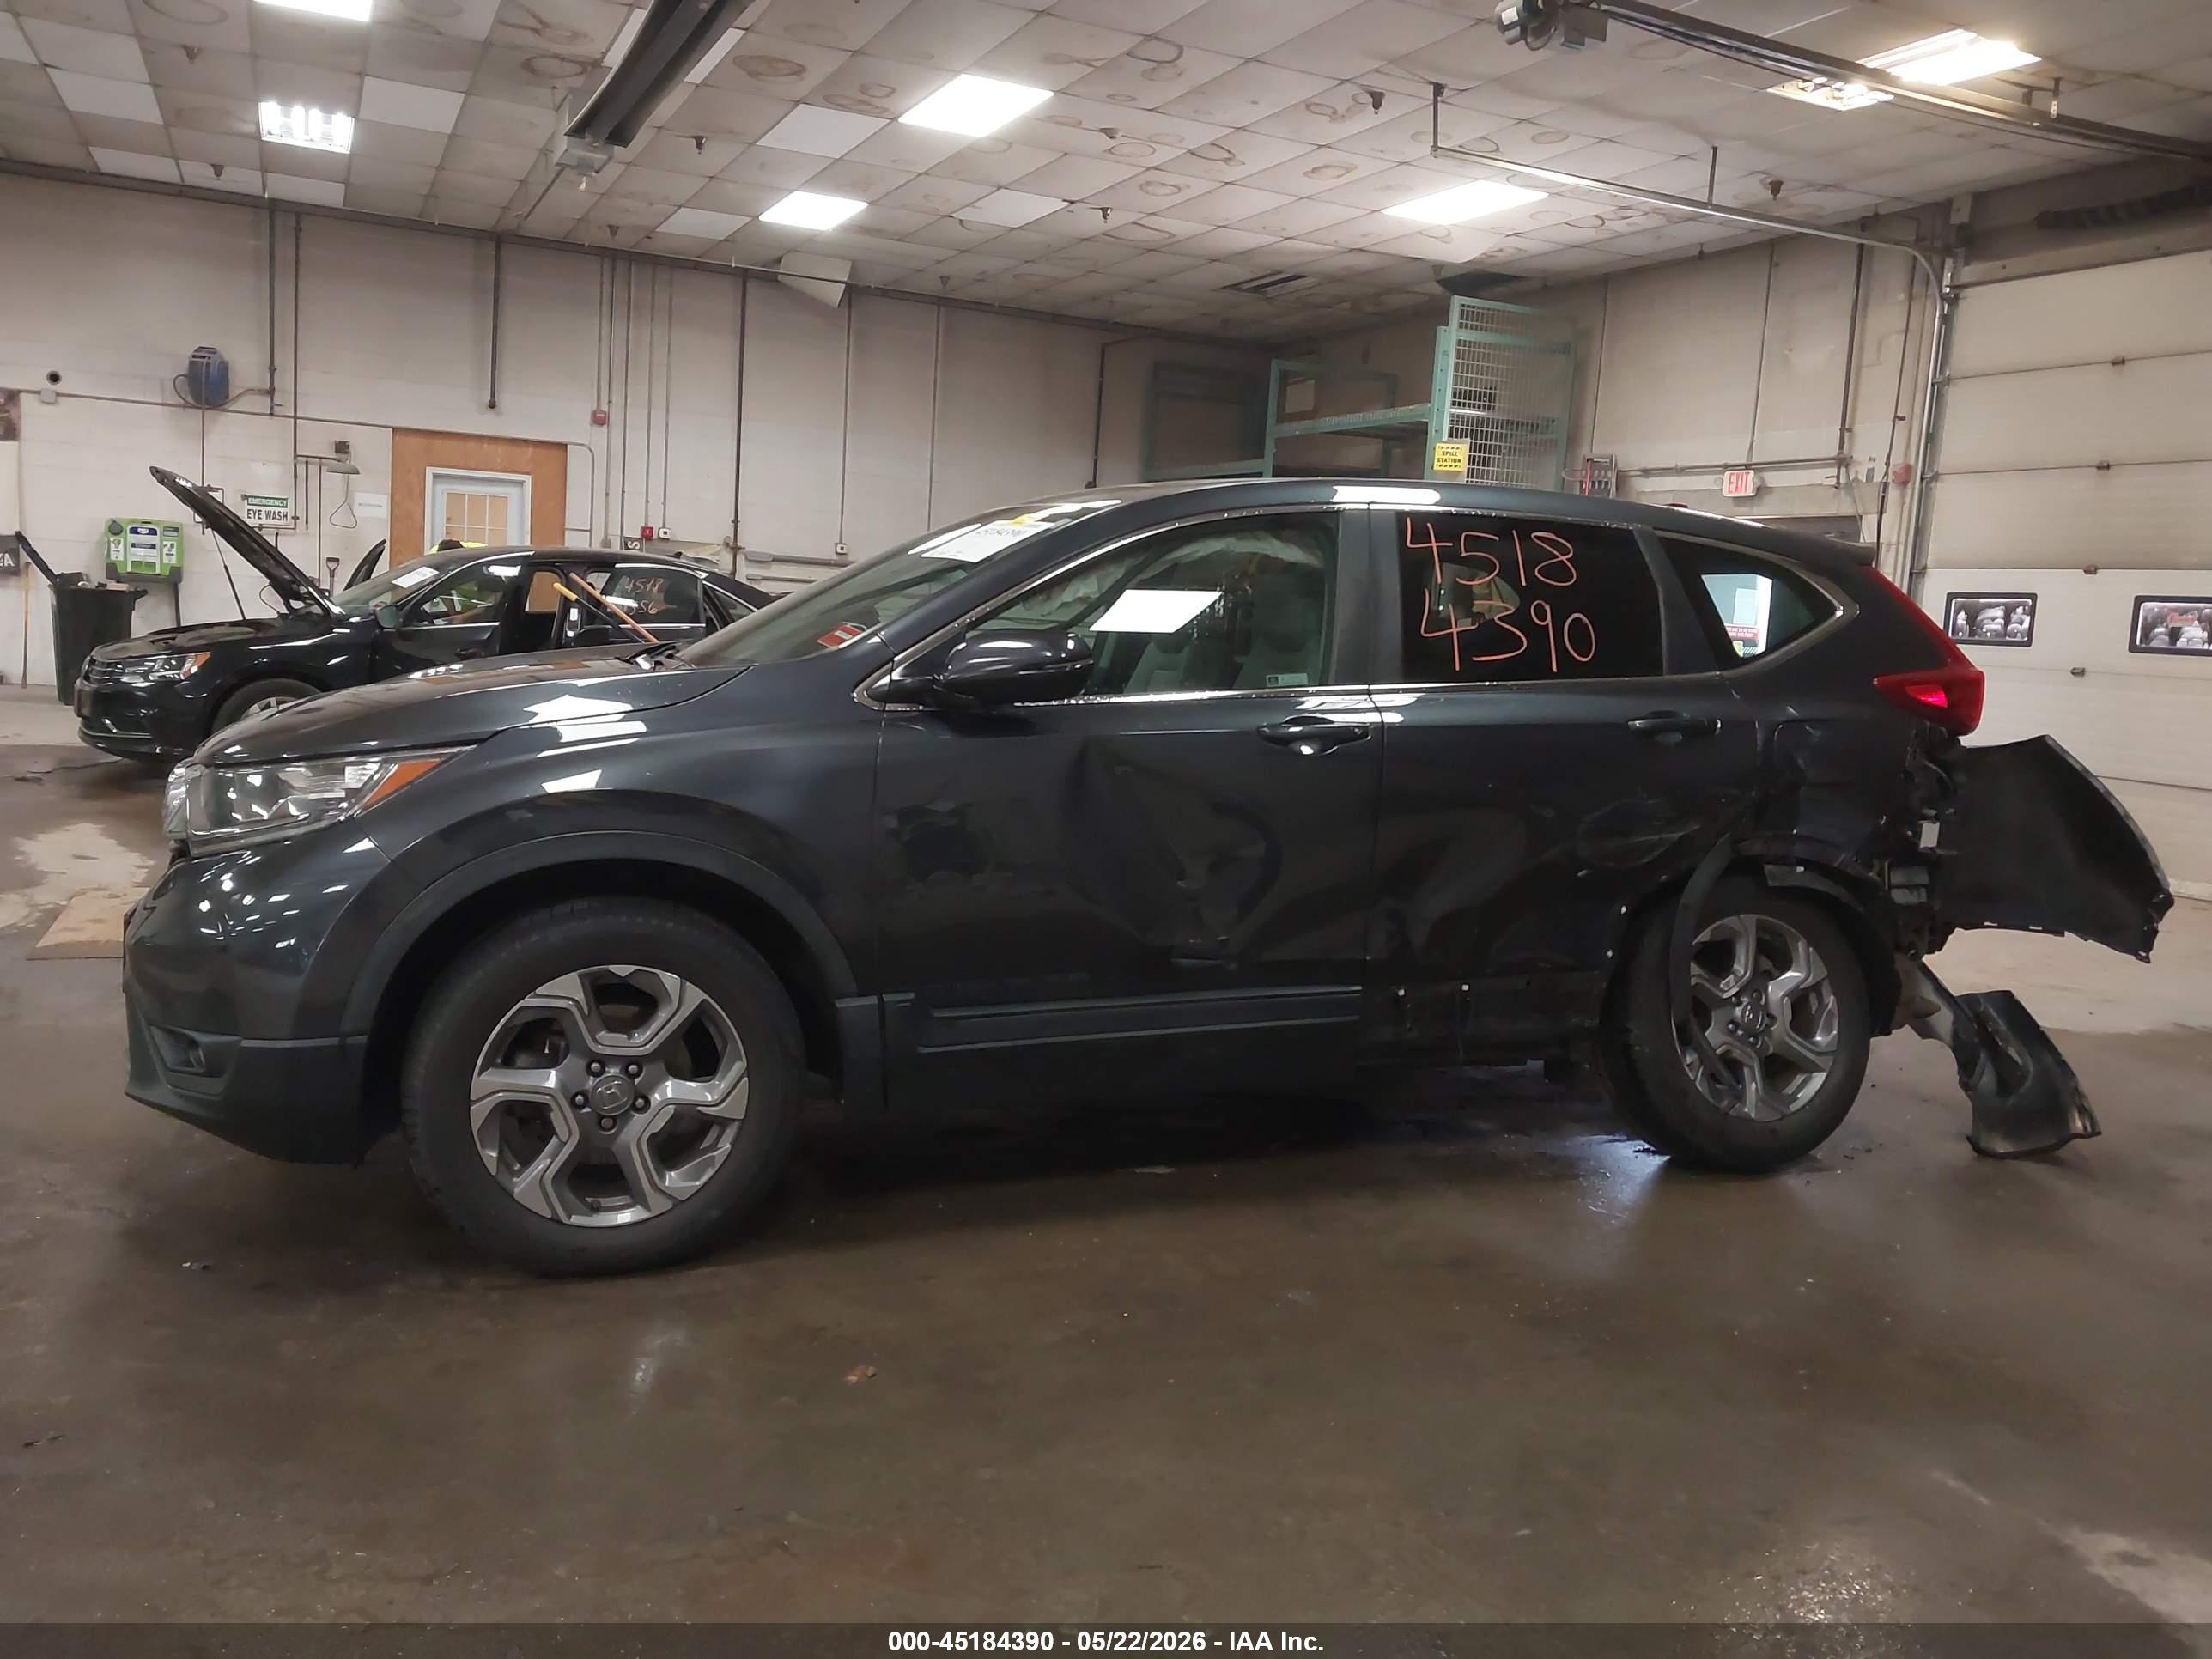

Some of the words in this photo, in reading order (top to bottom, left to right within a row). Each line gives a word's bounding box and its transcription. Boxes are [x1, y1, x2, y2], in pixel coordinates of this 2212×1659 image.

[1728, 471, 1750, 494] EXIT
[247, 497, 288, 507] EMERGENCY
[246, 508, 263, 520] EYE
[264, 509, 289, 521] WASH
[1407, 517, 1577, 586] 4518
[1420, 588, 1596, 673] 4390
